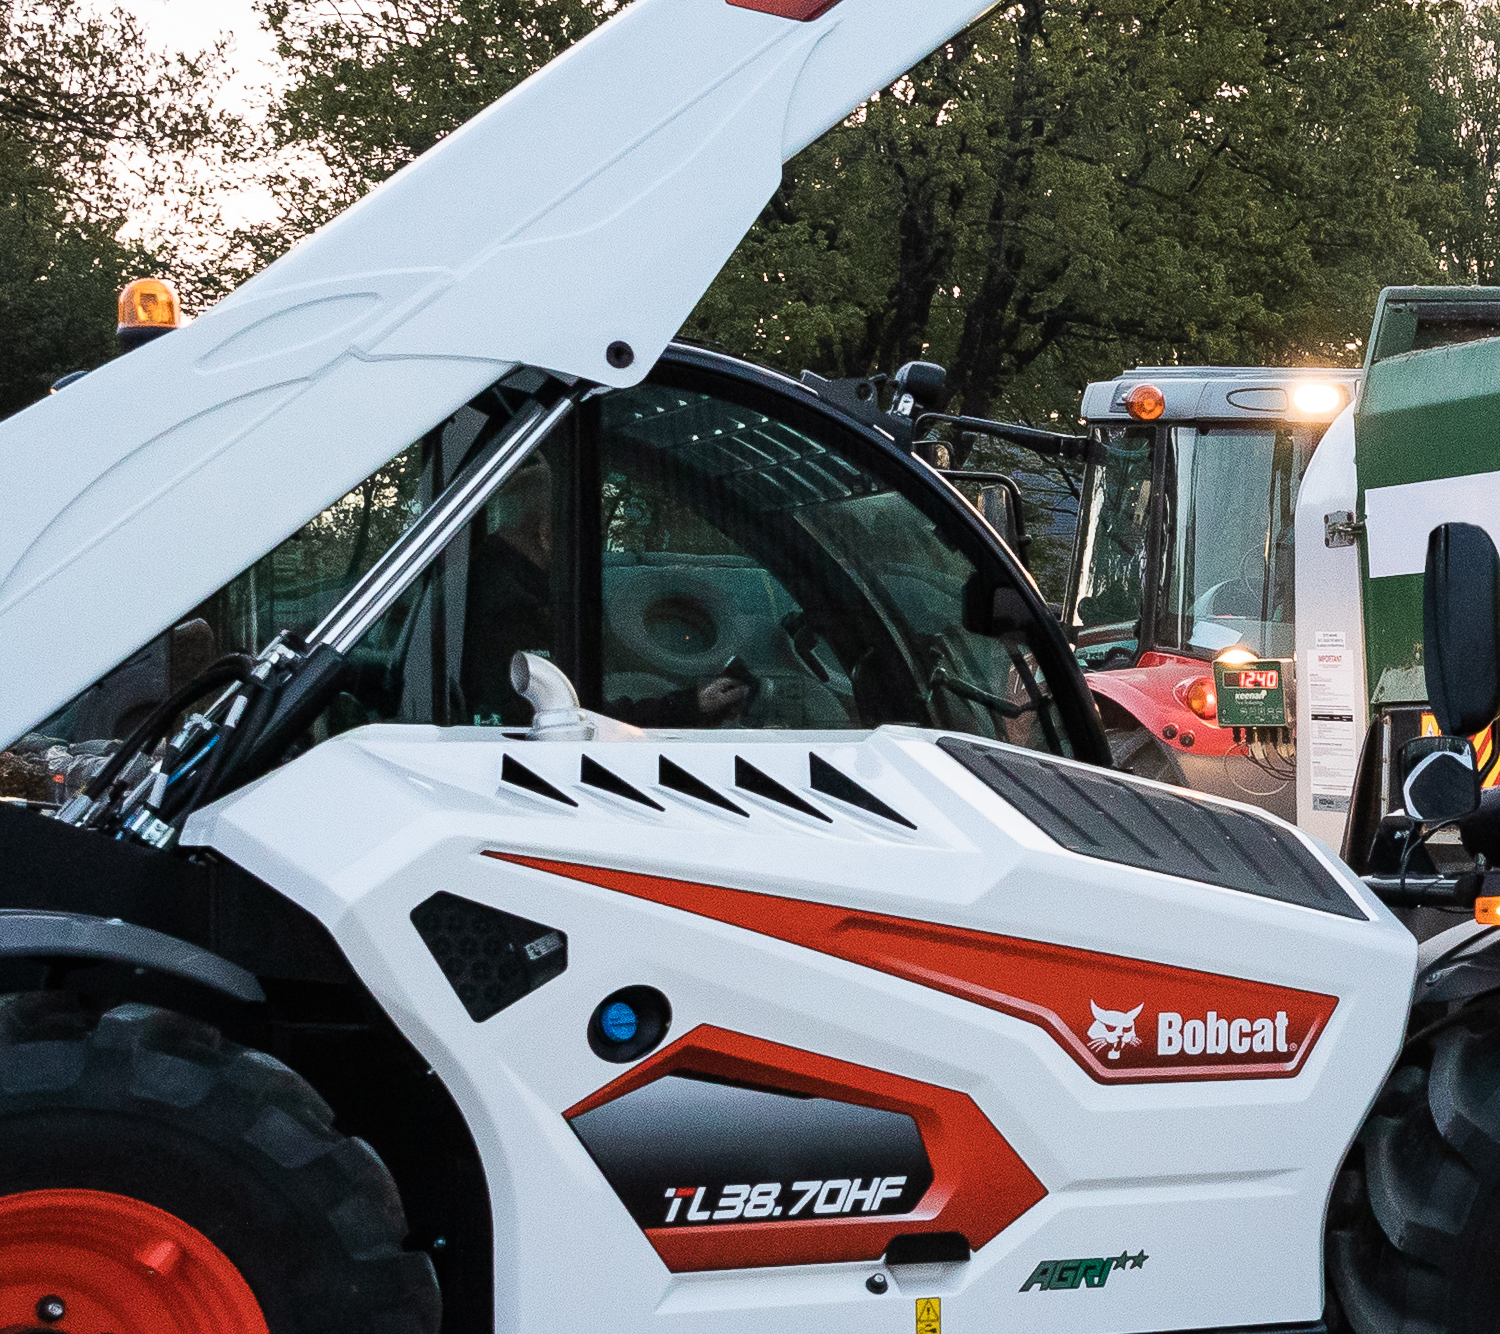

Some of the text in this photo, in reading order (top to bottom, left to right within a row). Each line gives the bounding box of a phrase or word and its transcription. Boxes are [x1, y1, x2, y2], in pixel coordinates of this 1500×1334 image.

[1240, 670, 1277, 688] 1240
[1157, 1011, 1290, 1056] Bobcat
[664, 1175, 908, 1223] TL38.70HF
[1018, 1257, 1115, 1293] AGRI
